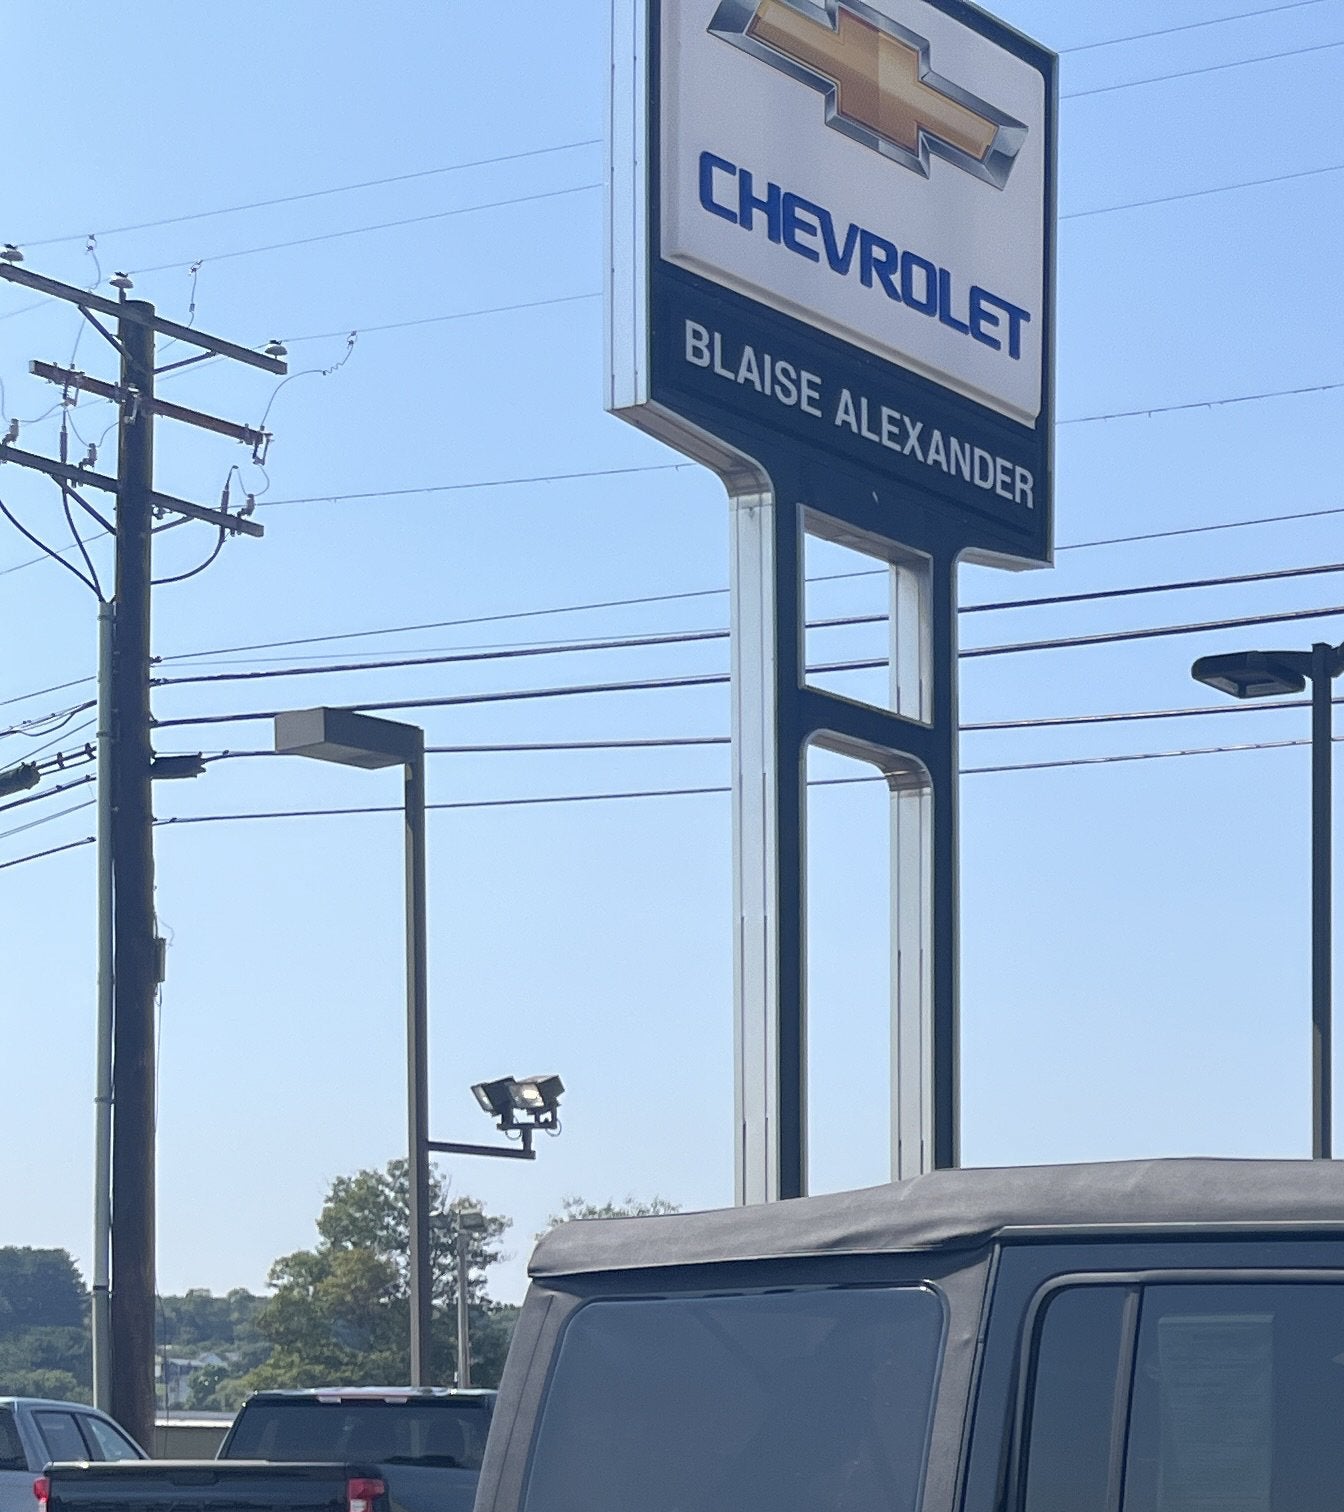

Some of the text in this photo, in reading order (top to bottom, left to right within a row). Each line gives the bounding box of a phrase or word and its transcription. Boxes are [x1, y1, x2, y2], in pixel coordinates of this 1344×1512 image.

[698, 150, 1031, 361] CHEVROLET
[685, 319, 1035, 510] BLAISE ALEXANDER
